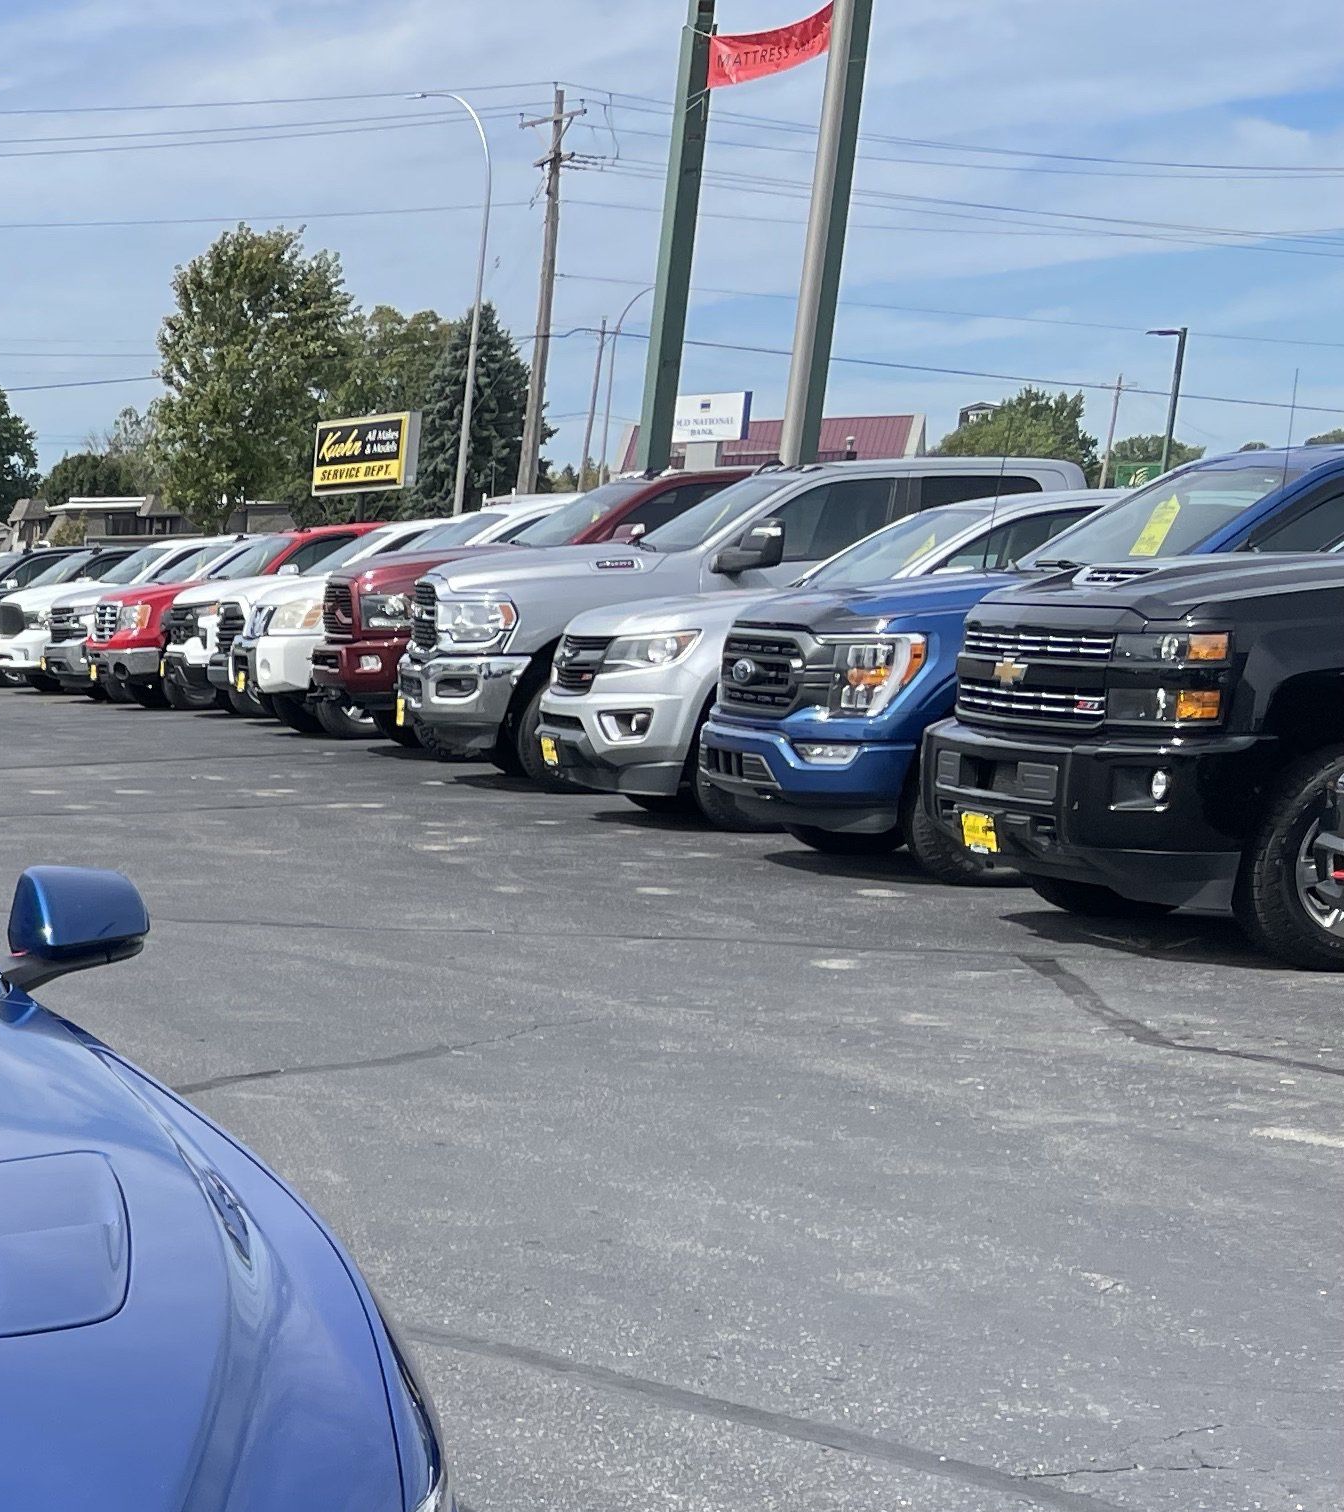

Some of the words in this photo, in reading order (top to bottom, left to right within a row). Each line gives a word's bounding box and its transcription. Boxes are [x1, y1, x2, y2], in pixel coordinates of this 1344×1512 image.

[717, 45, 790, 68] MATTRESS
[693, 416, 734, 426] NATIONAL
[366, 429, 377, 441] All
[377, 428, 399, 441] Makes
[690, 427, 714, 436] BANK
[318, 428, 363, 462] Kuehn
[364, 443, 372, 455] &
[372, 440, 398, 454] Models
[320, 466, 362, 481] SERVICE
[363, 463, 392, 478] DEPT.
